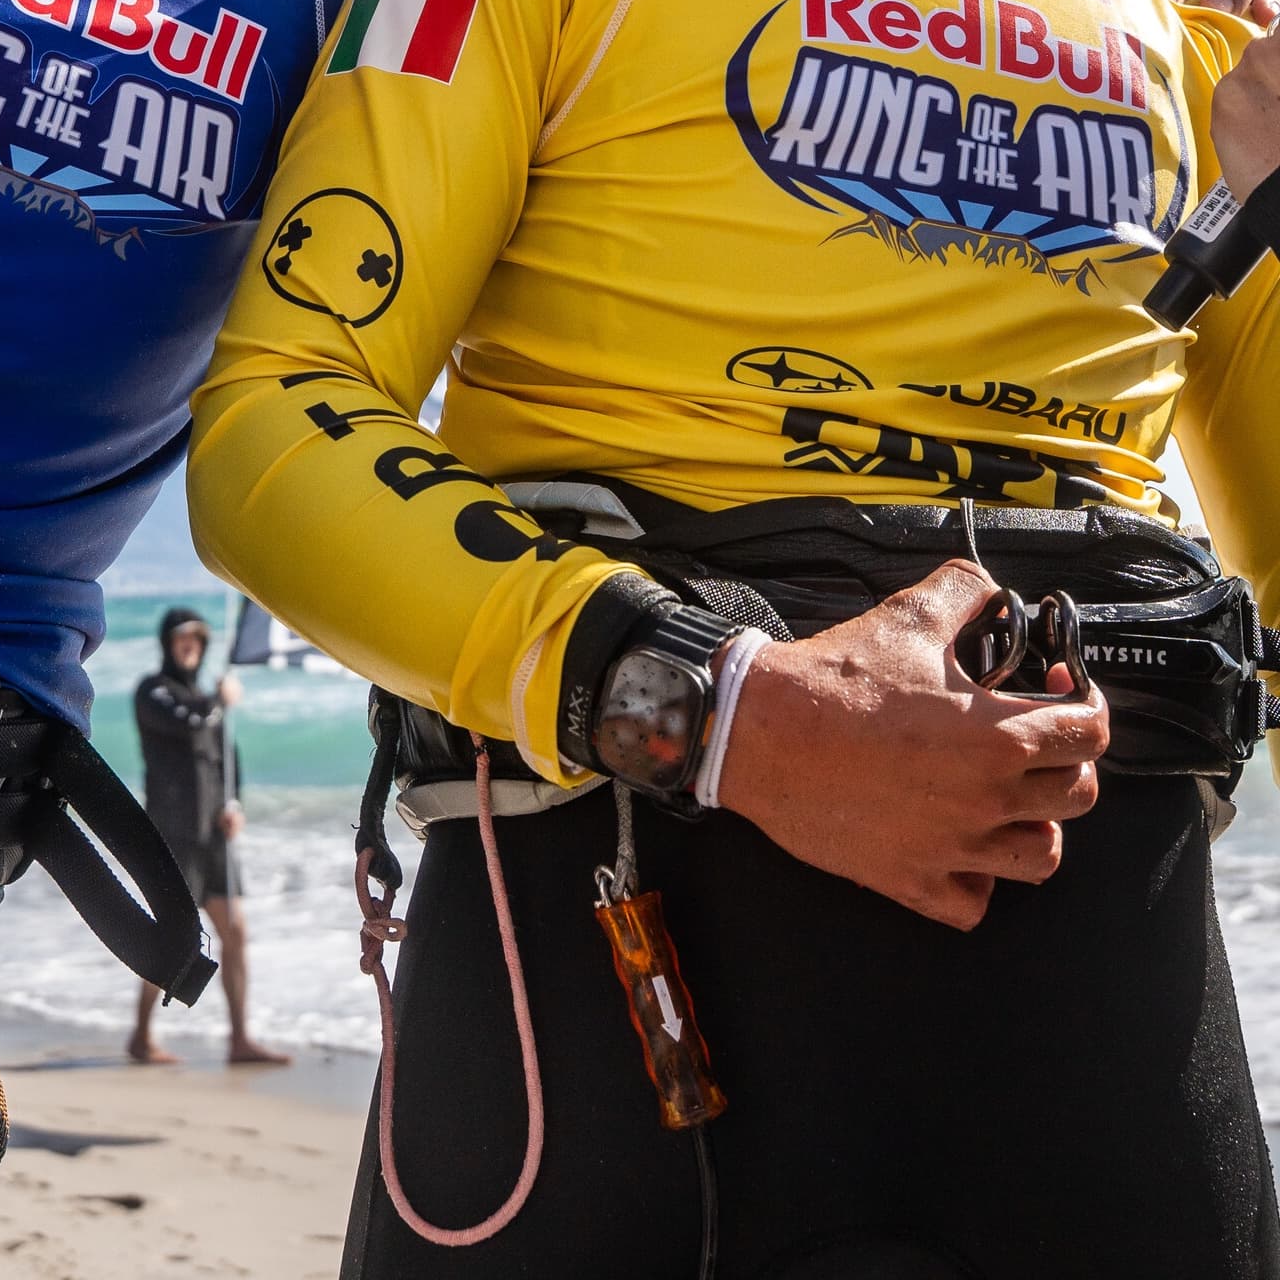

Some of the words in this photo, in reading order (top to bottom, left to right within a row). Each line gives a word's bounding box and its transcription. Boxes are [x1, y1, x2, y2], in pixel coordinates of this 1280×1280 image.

[41, 58, 92, 102] OF
[16, 86, 91, 149] THE
[769, 56, 954, 187] KING
[971, 102, 1011, 145] OF
[97, 81, 226, 221] AIR
[956, 138, 1018, 191] THE
[1032, 112, 1153, 230] AIR
[1083, 644, 1168, 667] MYSTIC
